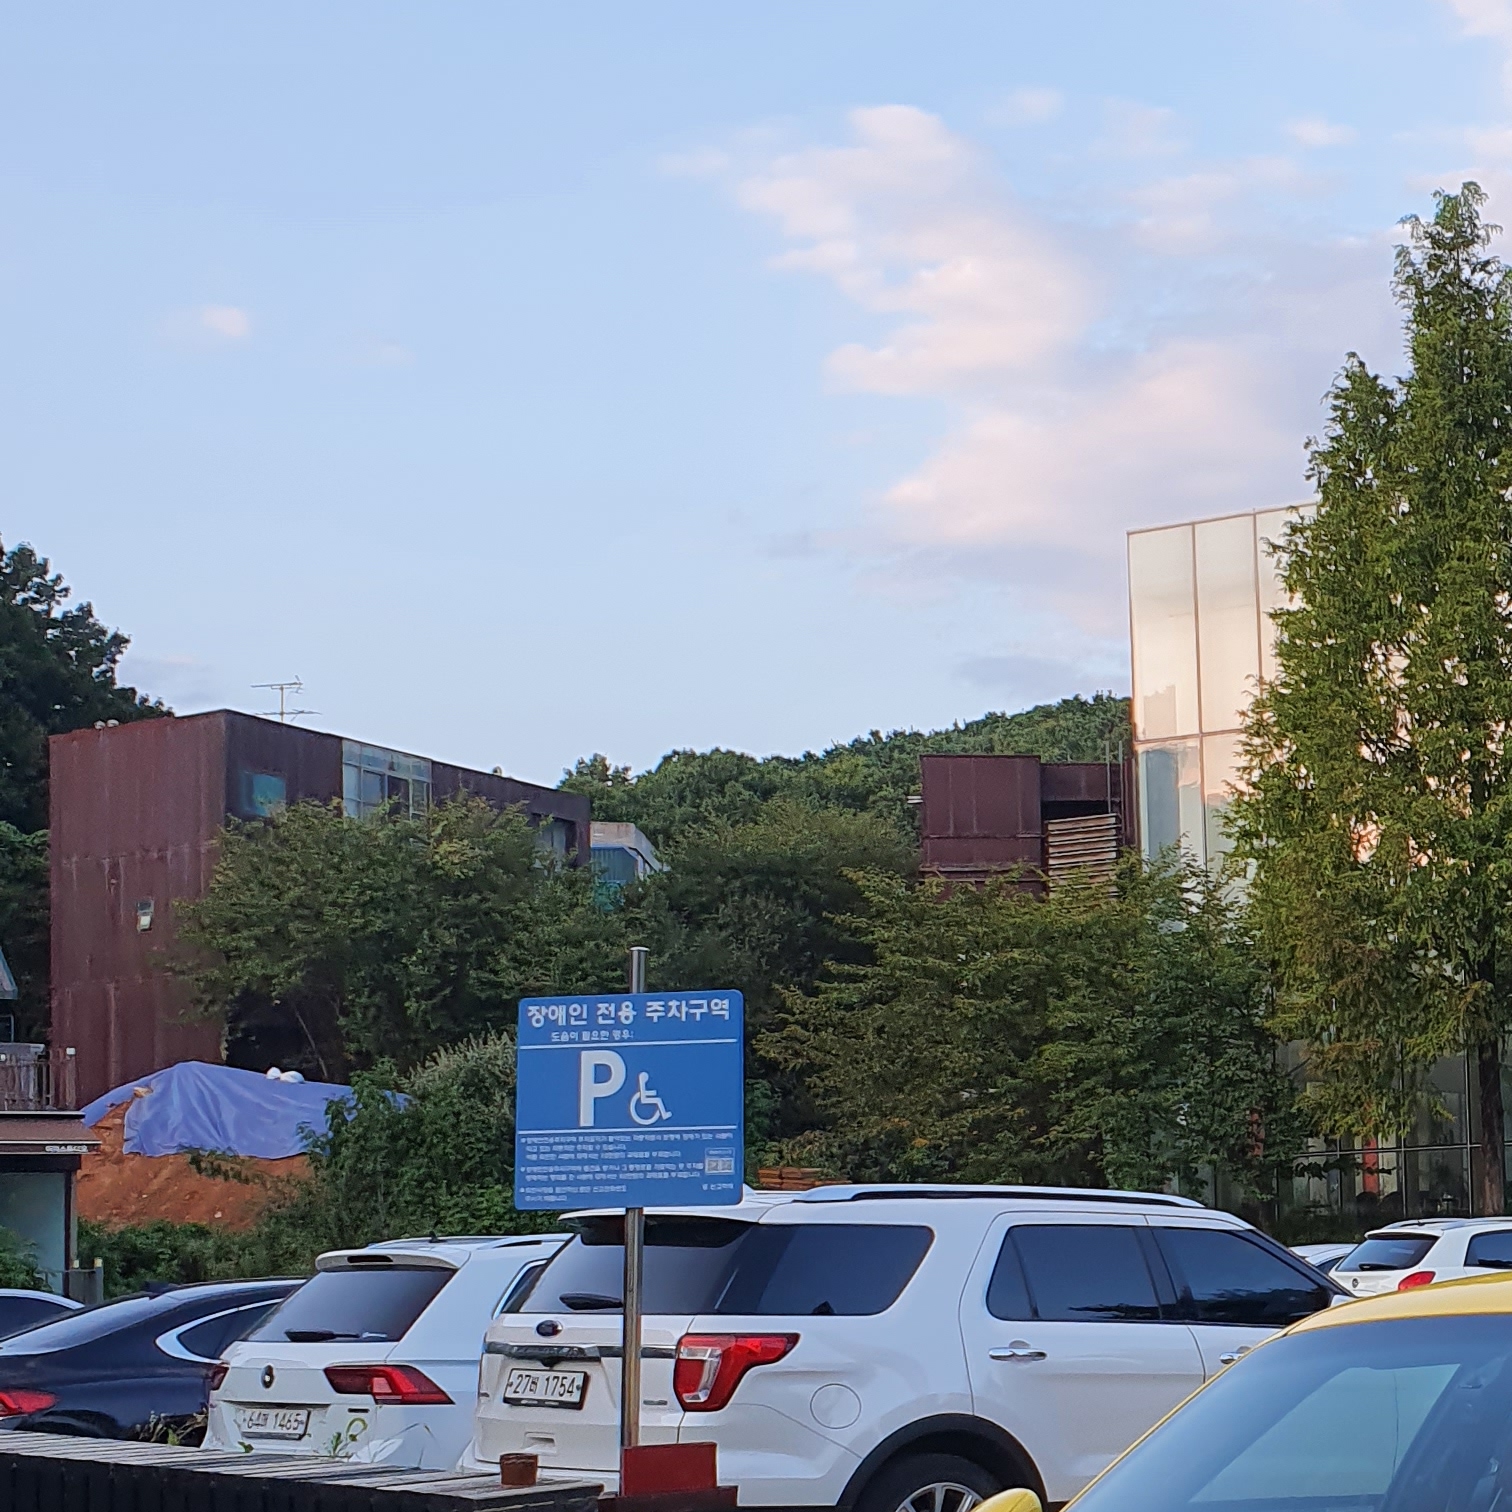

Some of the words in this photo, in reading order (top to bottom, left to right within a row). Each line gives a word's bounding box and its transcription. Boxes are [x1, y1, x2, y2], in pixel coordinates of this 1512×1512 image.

[527, 1002, 588, 1028] 장애인
[596, 1000, 637, 1025] 전용
[645, 998, 730, 1023] 주차구역
[578, 1050, 627, 1127] P
[544, 1375, 576, 1397] 1754
[273, 1412, 302, 1431] 1465
